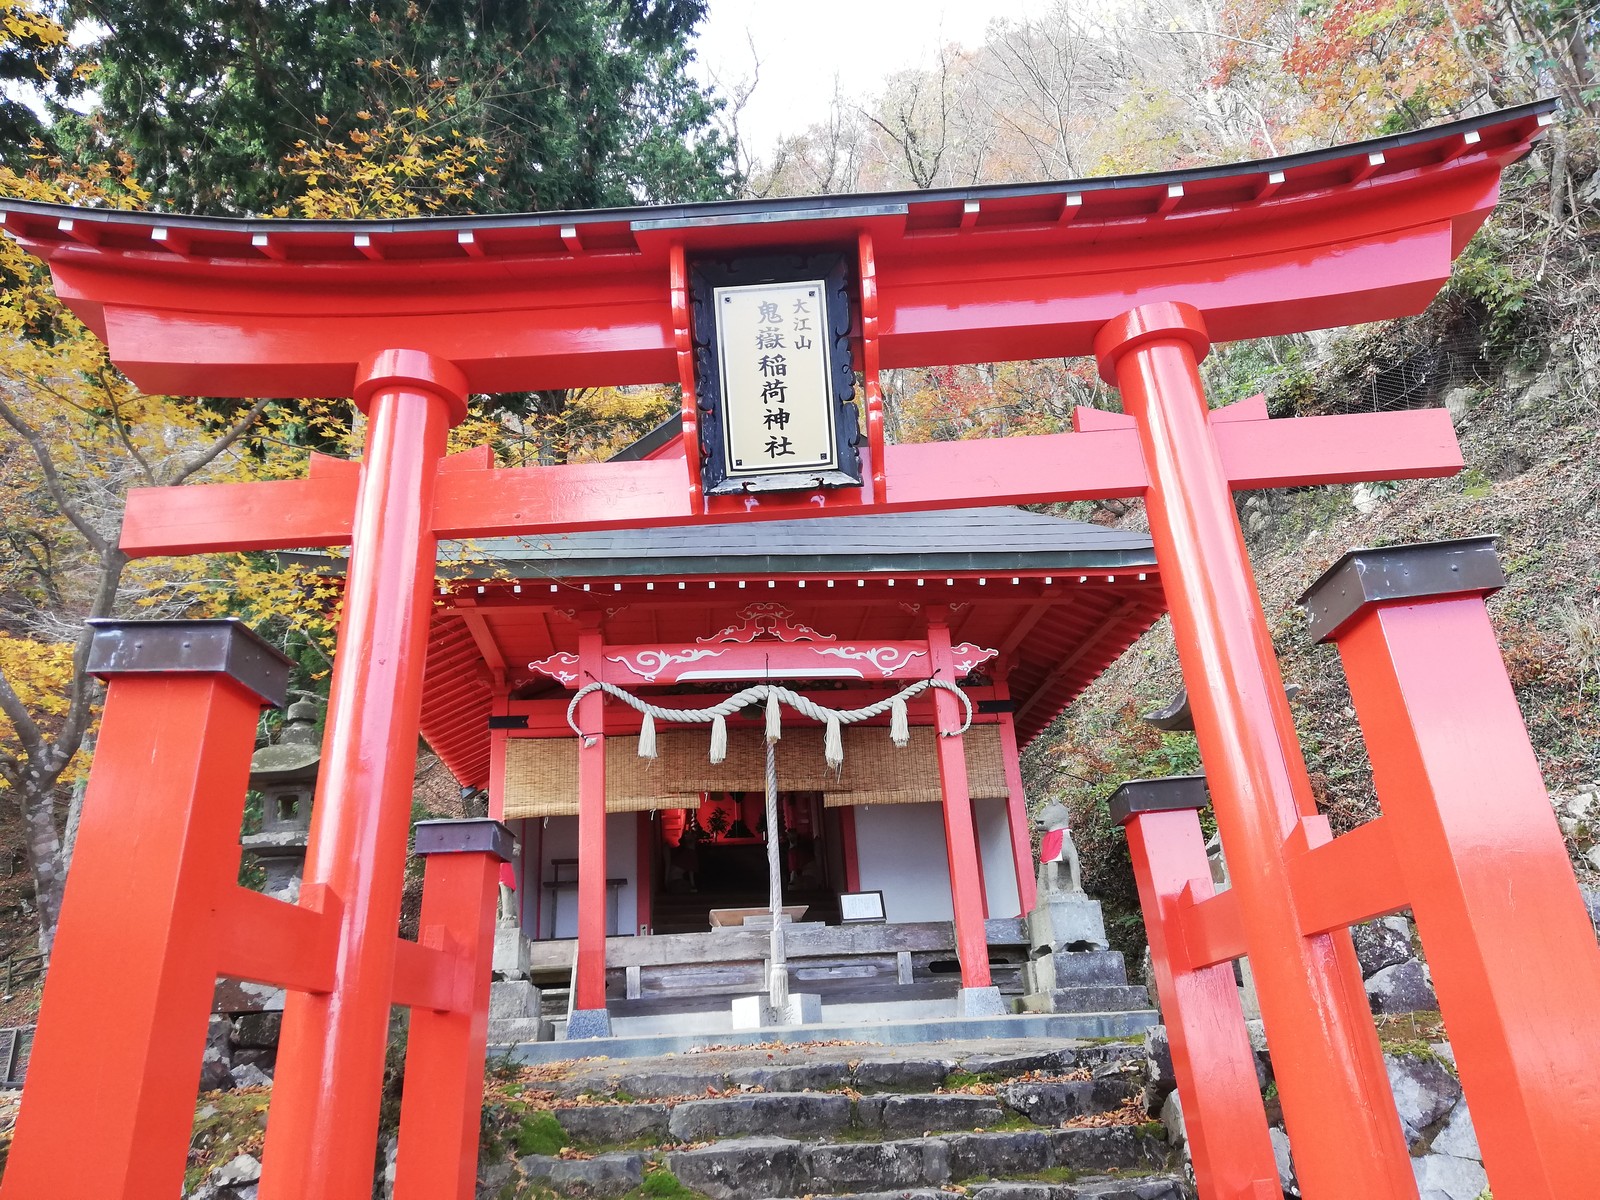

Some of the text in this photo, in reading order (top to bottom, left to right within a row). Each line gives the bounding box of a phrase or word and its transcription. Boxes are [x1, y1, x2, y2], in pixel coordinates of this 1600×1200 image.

[792, 299, 812, 350] 大江山
[755, 301, 796, 458] 鬼嶽稲荷神社
